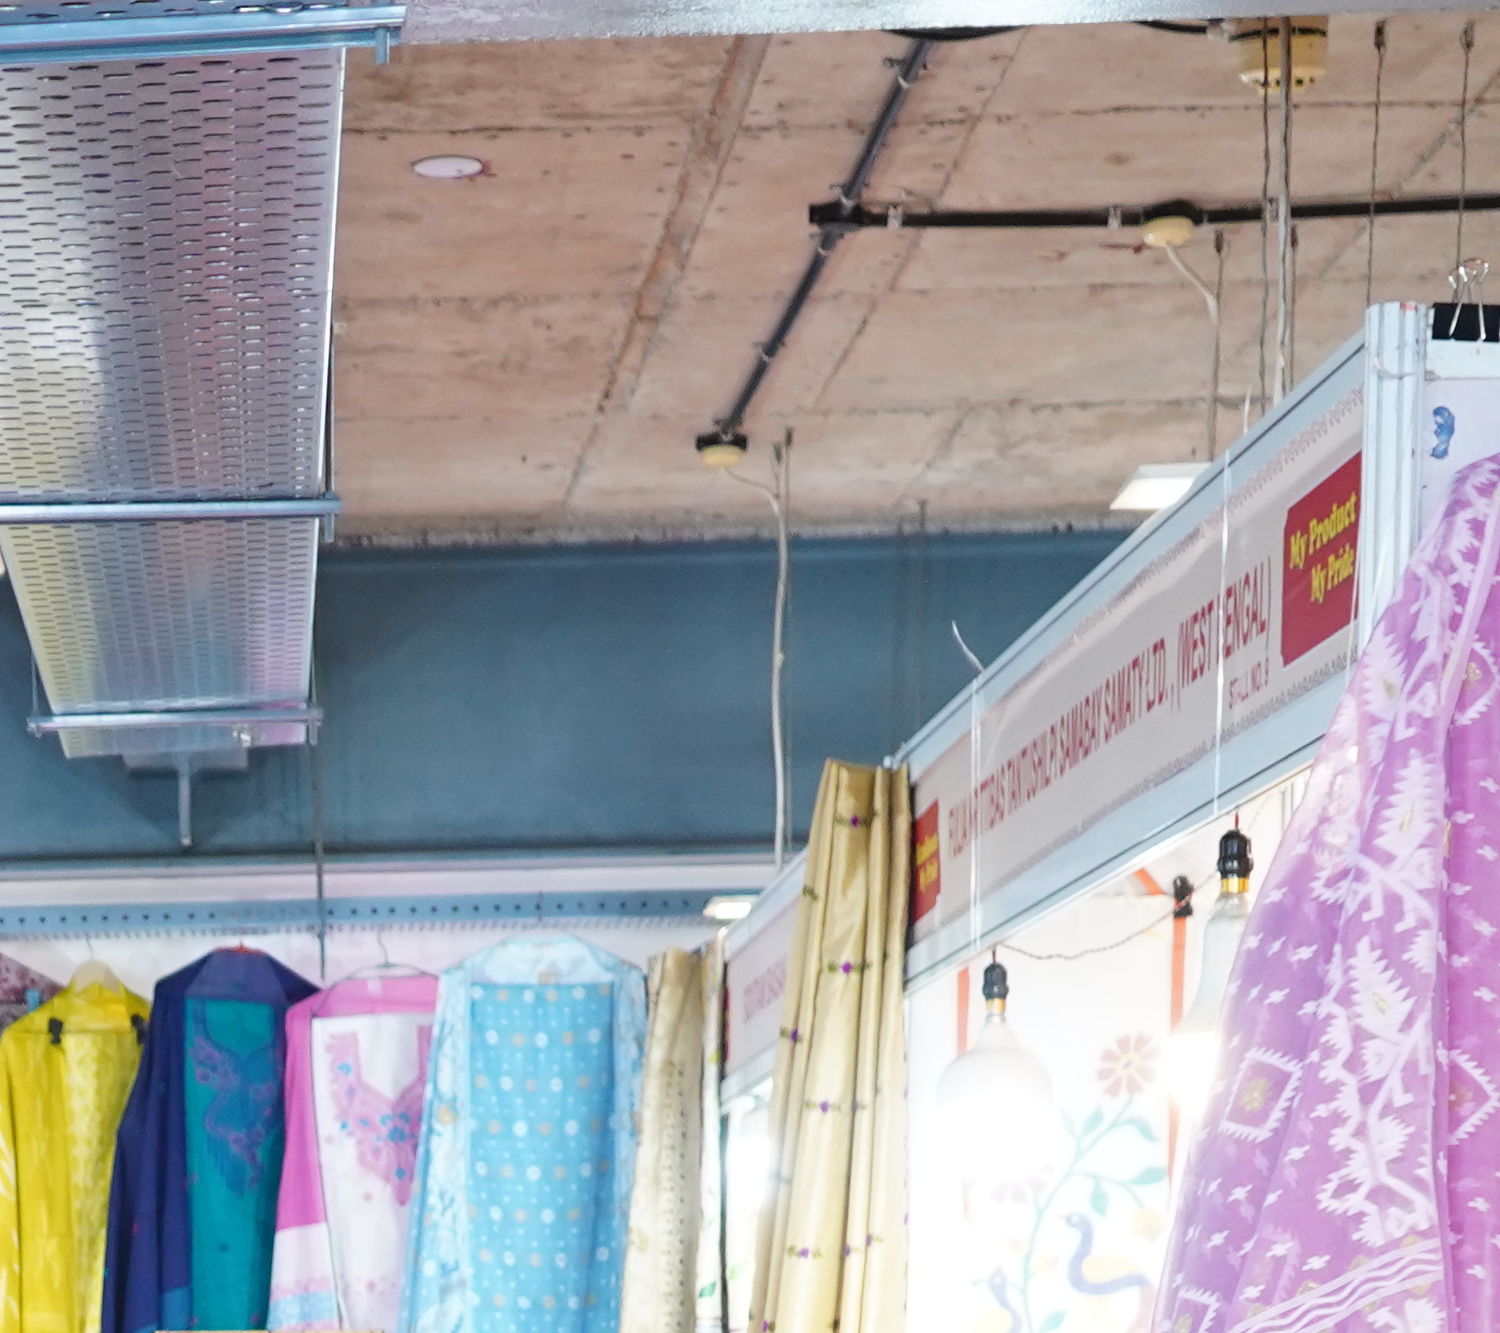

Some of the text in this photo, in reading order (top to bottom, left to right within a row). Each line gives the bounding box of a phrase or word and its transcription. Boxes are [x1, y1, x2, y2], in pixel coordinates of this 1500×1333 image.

[1289, 491, 1357, 569] My Product
[1310, 542, 1355, 603] My Pride
[1177, 598, 1215, 712] (WEST
